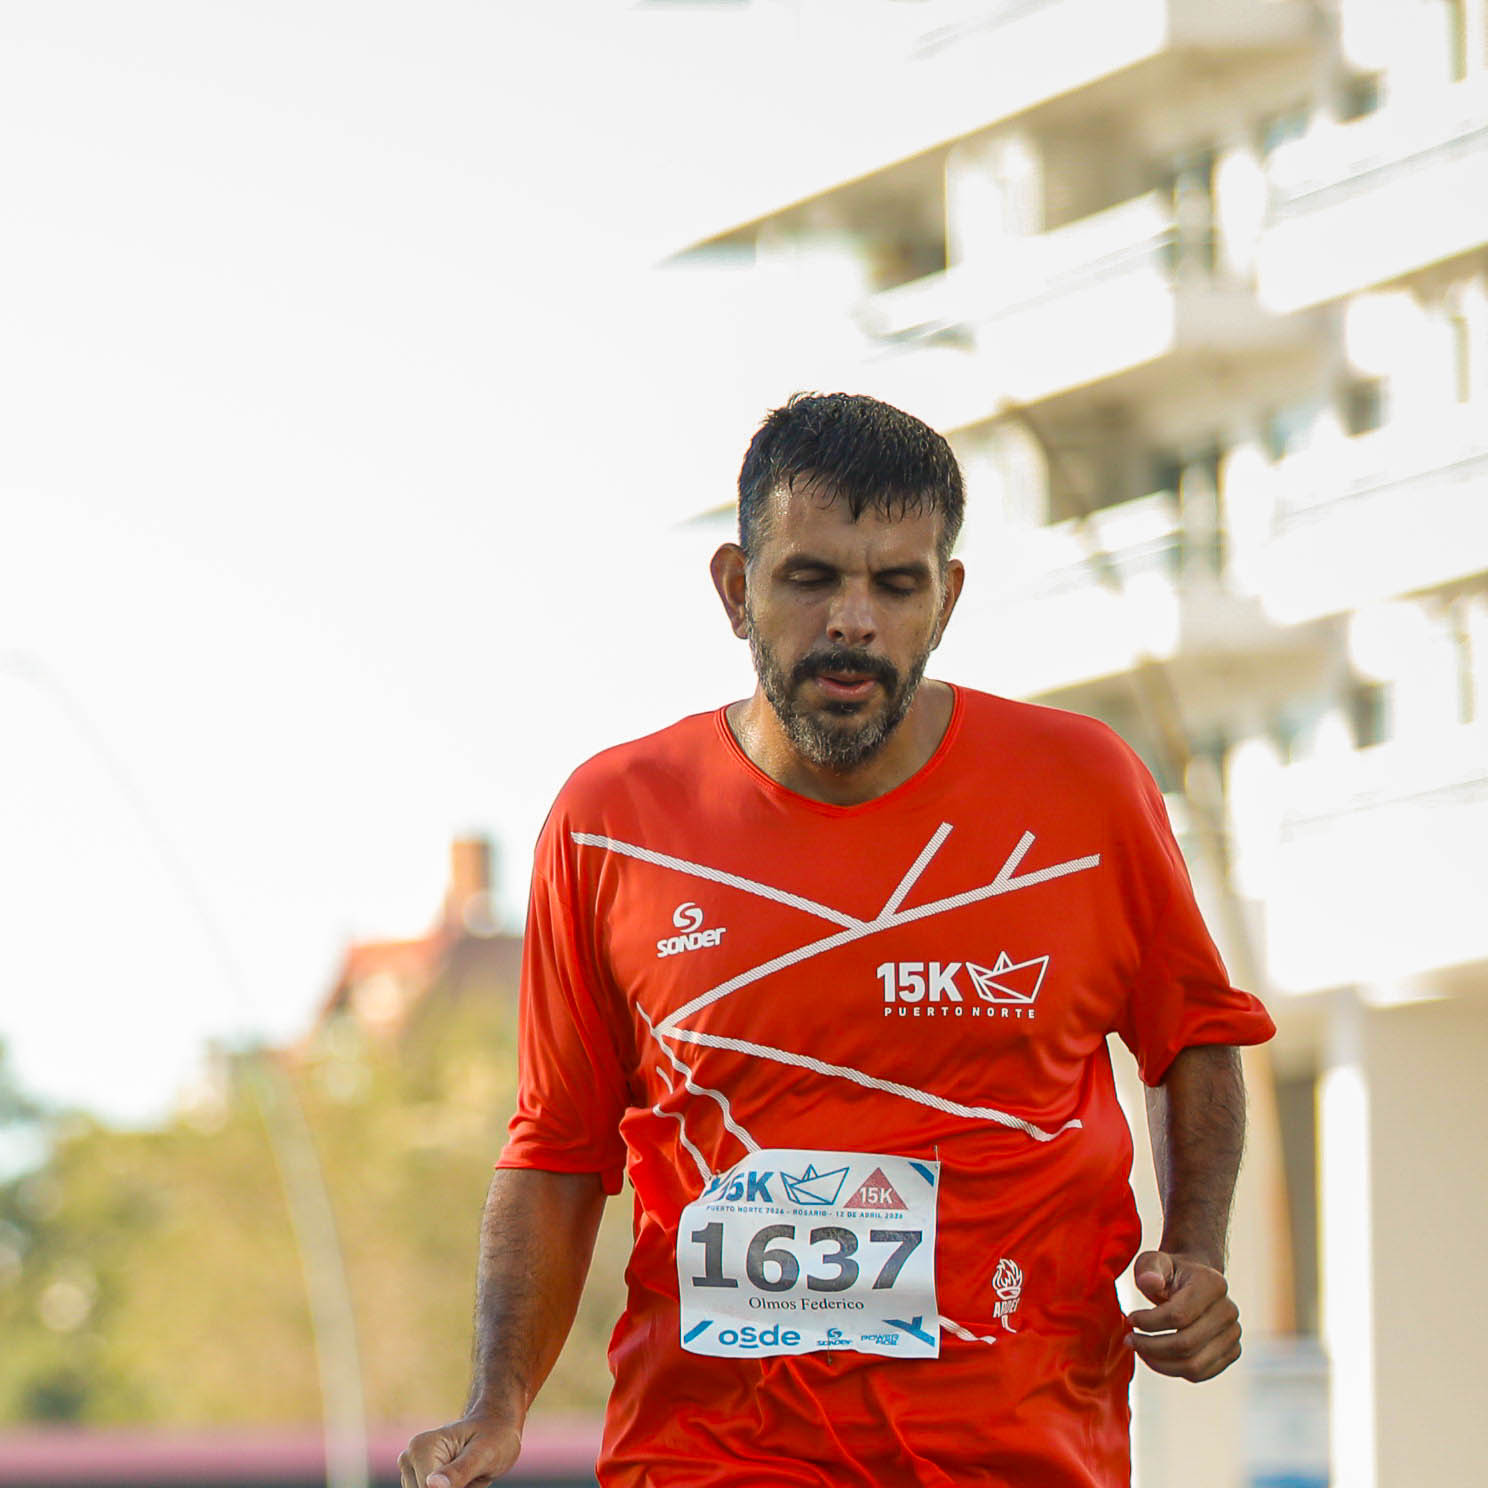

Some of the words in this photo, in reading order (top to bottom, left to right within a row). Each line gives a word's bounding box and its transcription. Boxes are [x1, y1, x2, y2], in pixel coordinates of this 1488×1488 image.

[876, 961, 964, 1003] 15K
[884, 1006, 963, 1017] PUERTO
[972, 1007, 1035, 1019] NORTE
[859, 1187, 894, 1205] 15K
[706, 1204, 735, 1213] PUERTO
[738, 1206, 763, 1214] NORTE
[792, 1208, 827, 1217] ROSARIO
[691, 1222, 923, 1292] 1637
[749, 1296, 796, 1311] Olmos
[801, 1297, 865, 1311] Federico
[718, 1323, 801, 1349] osde
